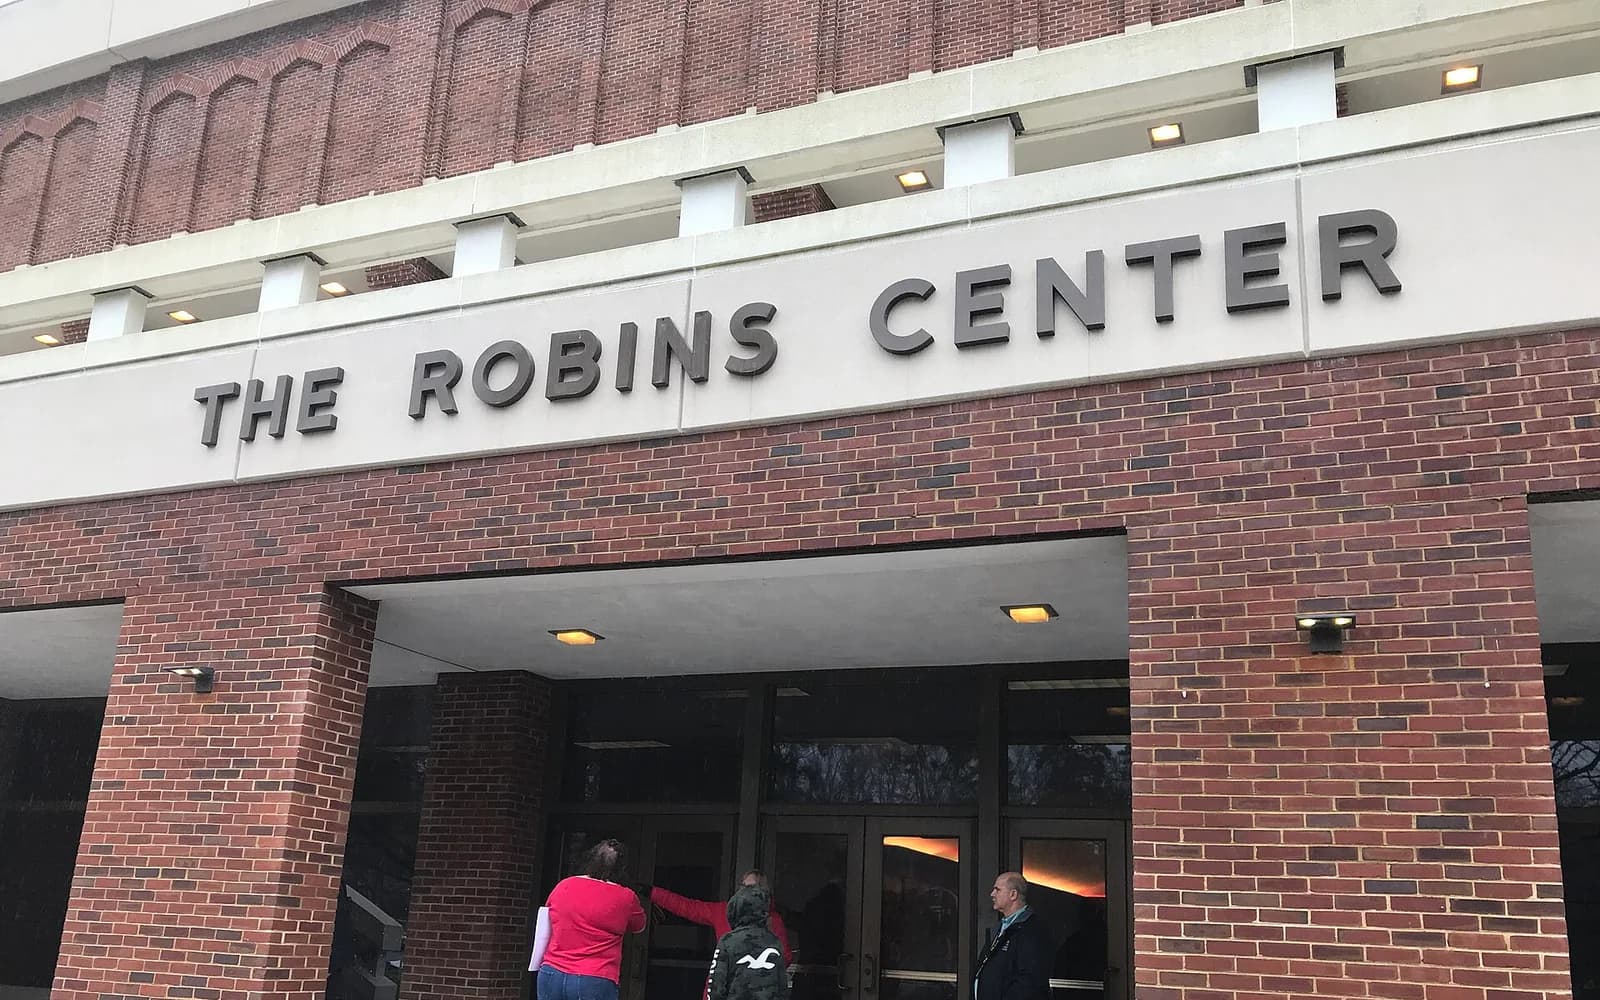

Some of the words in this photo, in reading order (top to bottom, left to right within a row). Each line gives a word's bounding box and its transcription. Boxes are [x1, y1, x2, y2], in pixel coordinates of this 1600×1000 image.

[194, 366, 345, 448] THE
[408, 302, 778, 420] ROBINS
[869, 209, 1402, 357] CENTER
